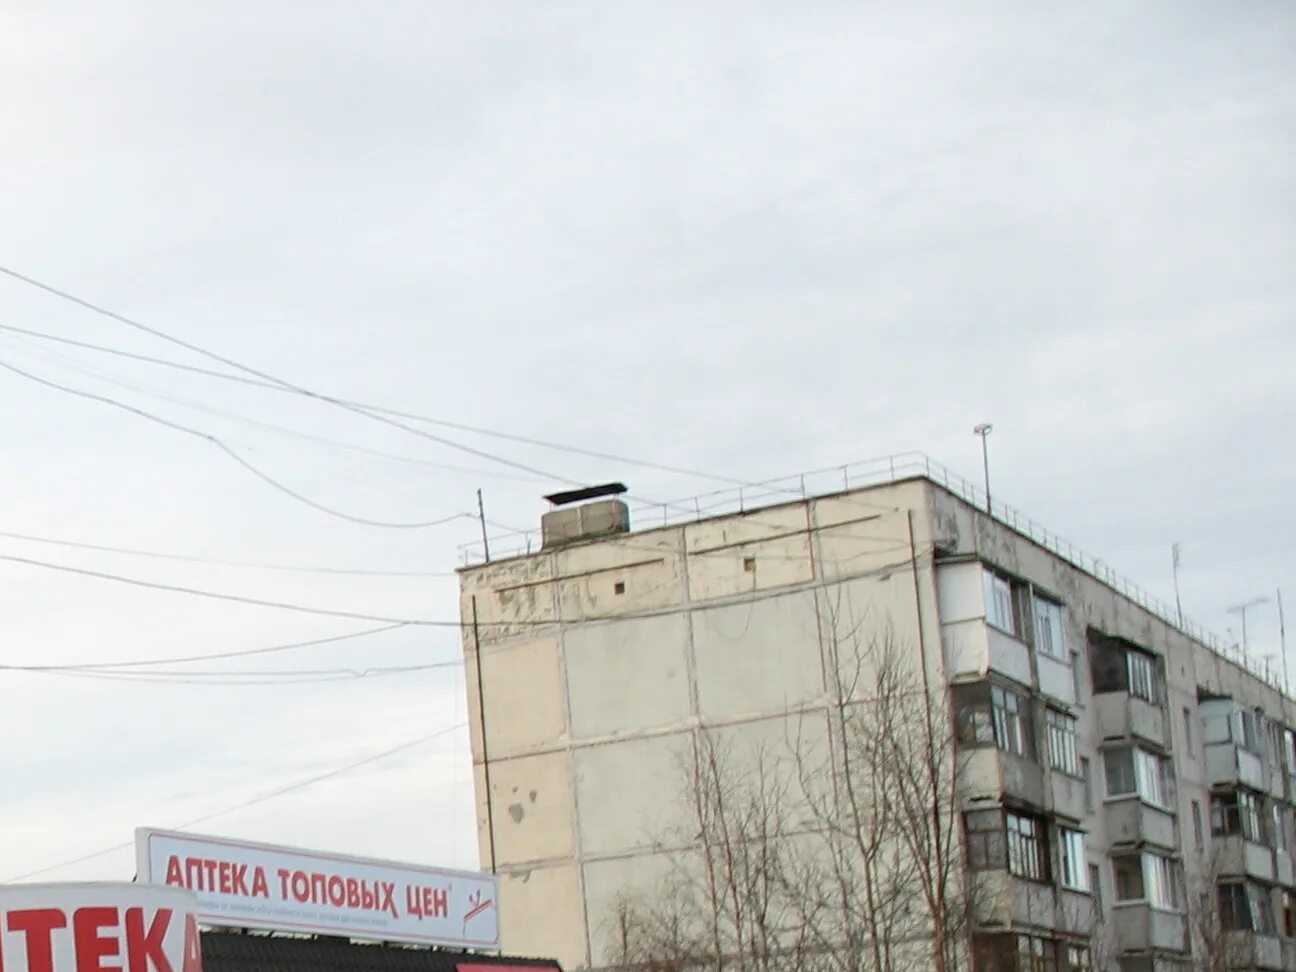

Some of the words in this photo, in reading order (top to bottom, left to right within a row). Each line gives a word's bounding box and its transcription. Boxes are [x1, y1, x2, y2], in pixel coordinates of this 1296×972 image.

[165, 855, 270, 898] АПТЕКА
[277, 868, 399, 919] ТОПОВЫХ
[406, 884, 449, 920] ЦЕН
